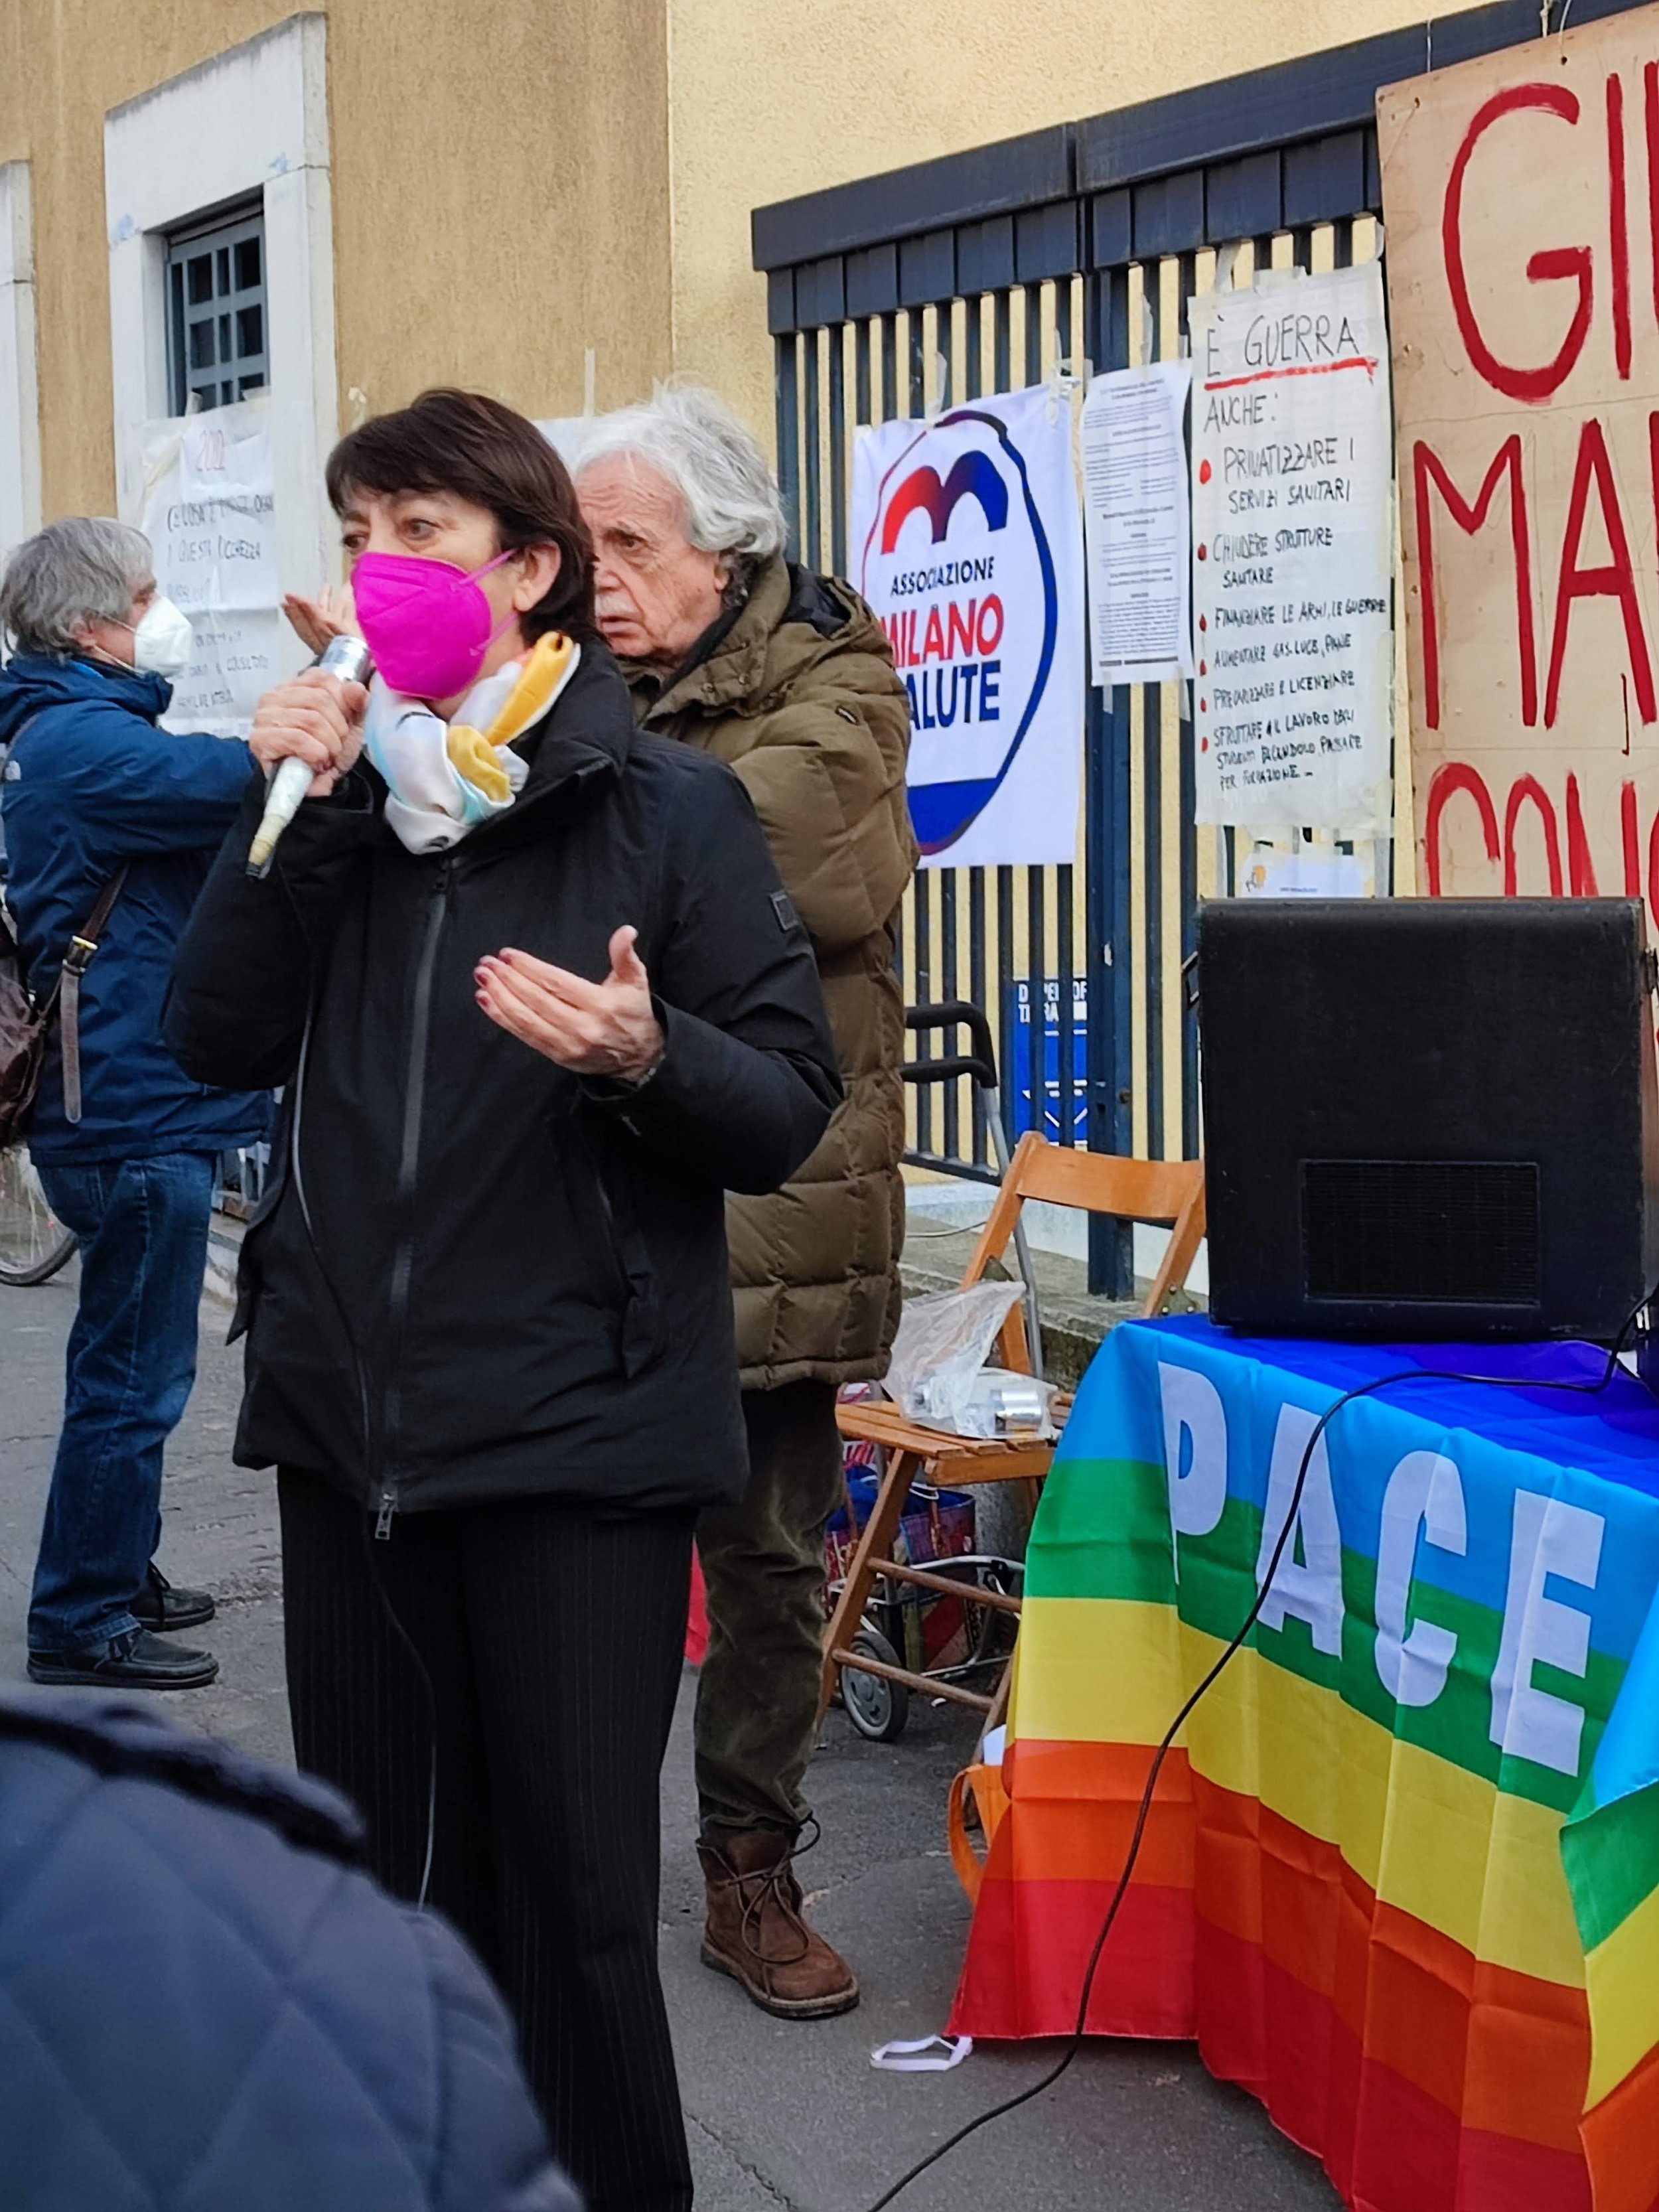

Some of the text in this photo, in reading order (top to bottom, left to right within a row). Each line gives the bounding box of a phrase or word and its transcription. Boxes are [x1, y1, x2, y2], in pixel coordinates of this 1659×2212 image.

[1244, 314, 1360, 367] GUERRA
[1224, 437, 1338, 483] PRIVATIZZARE
[1287, 477, 1350, 506] SANITARI
[1212, 532, 1269, 564] CHIUDERE
[1413, 410, 1659, 729] MA
[891, 556, 995, 596] ASSOCIAZIONE
[1281, 603, 1295, 624] LE
[905, 659, 1001, 731] ALUTE
[1285, 710, 1330, 733] LAVORO
[1158, 1360, 1605, 1777] PACE
